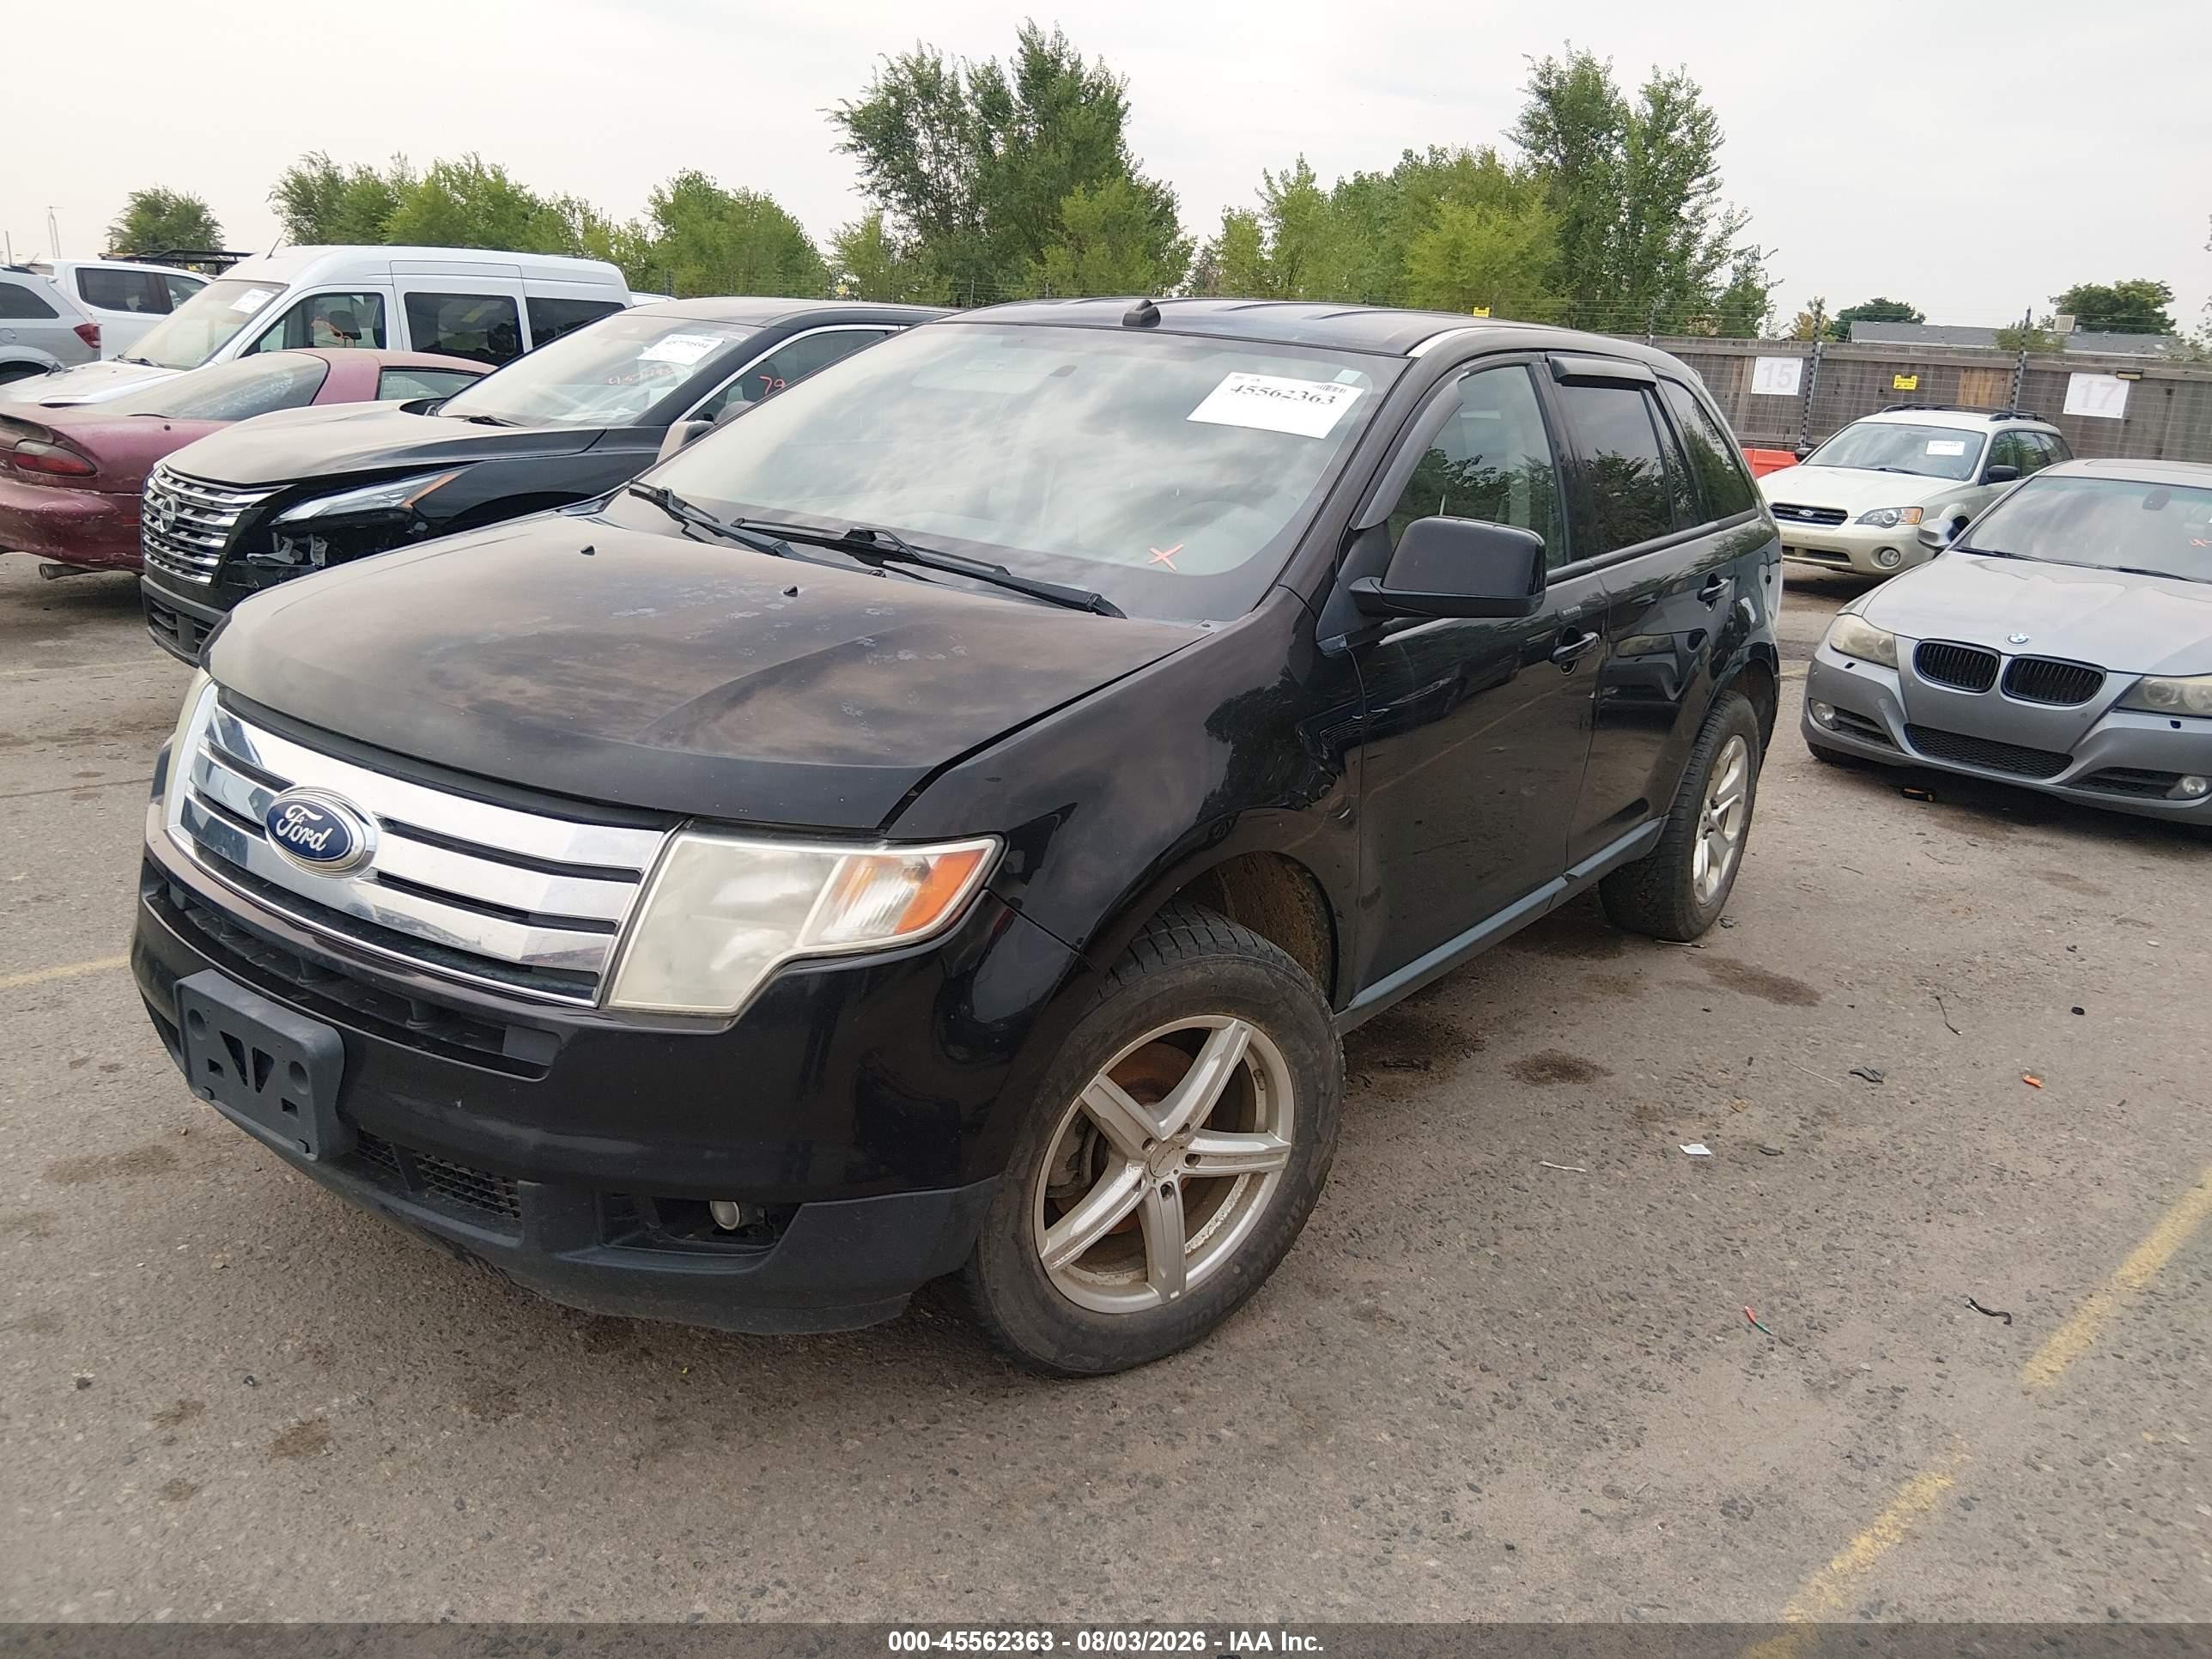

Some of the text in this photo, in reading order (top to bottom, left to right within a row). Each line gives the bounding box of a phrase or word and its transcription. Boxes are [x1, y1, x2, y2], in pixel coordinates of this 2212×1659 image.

[1763, 362, 1794, 388] 15
[1230, 384, 1337, 405] 45562363
[2079, 380, 2120, 410] 17
[276, 805, 333, 851] Ford
